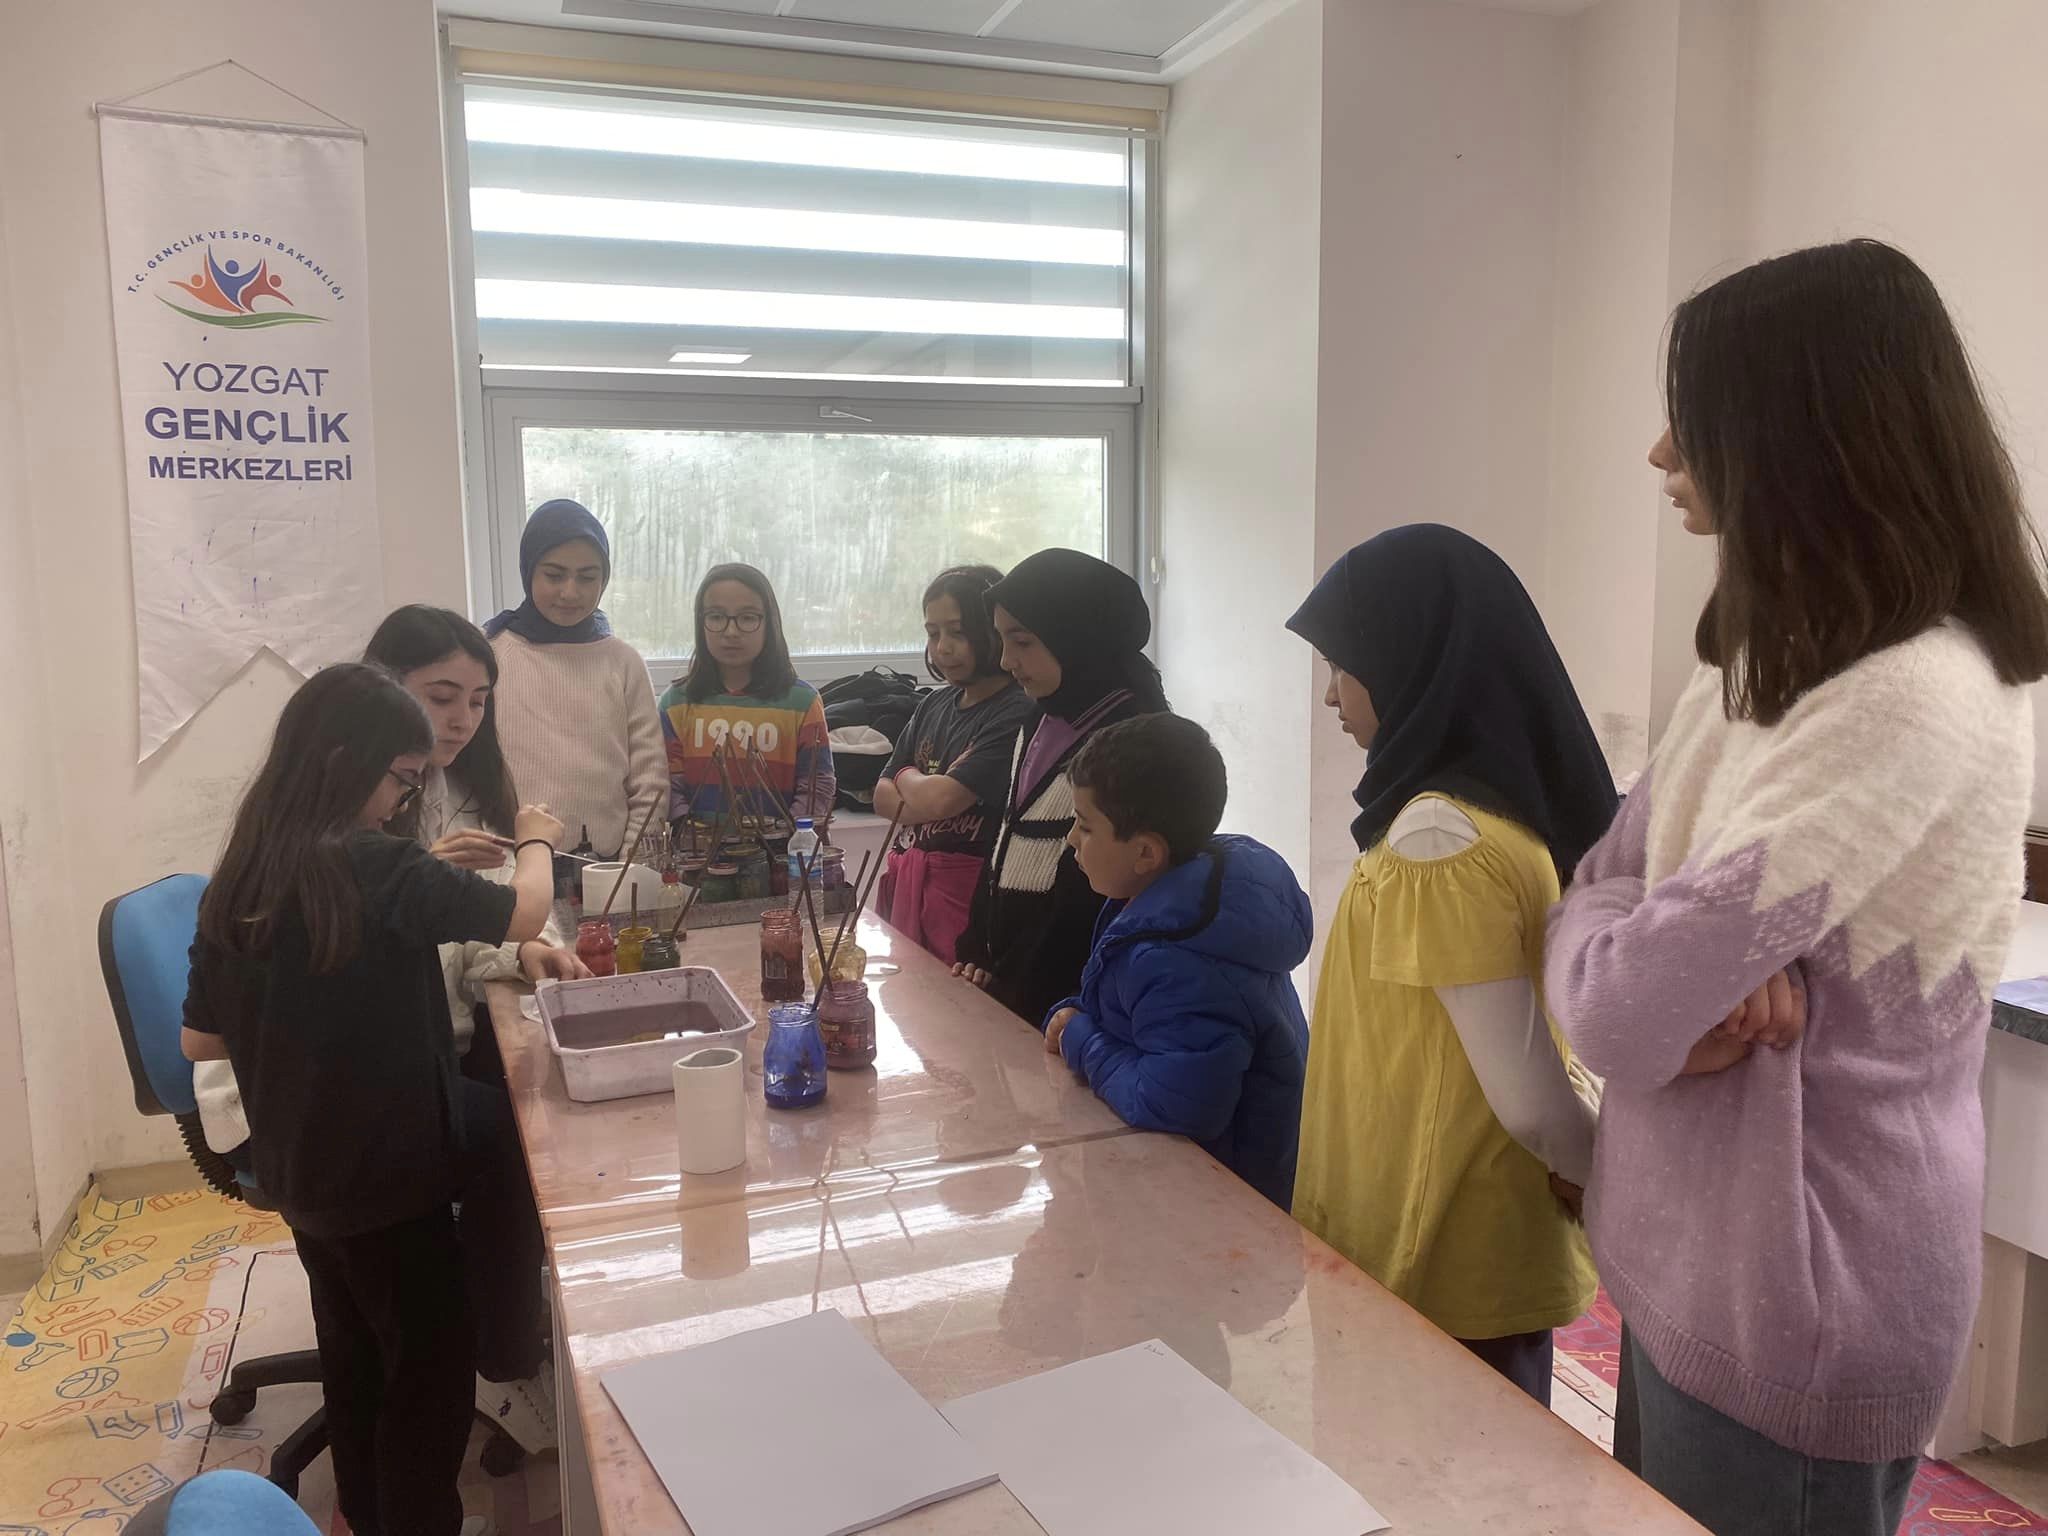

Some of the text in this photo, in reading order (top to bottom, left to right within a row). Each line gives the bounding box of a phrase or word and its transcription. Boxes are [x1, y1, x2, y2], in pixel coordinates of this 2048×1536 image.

[127, 231, 344, 301] T.C. GENÇLİK VE SPOR BAKANLIĞI
[162, 362, 329, 396] YOZGAT
[144, 405, 350, 445] GENÇLİK
[148, 454, 352, 481] MERKEZLERİ
[694, 718, 778, 752] 1990
